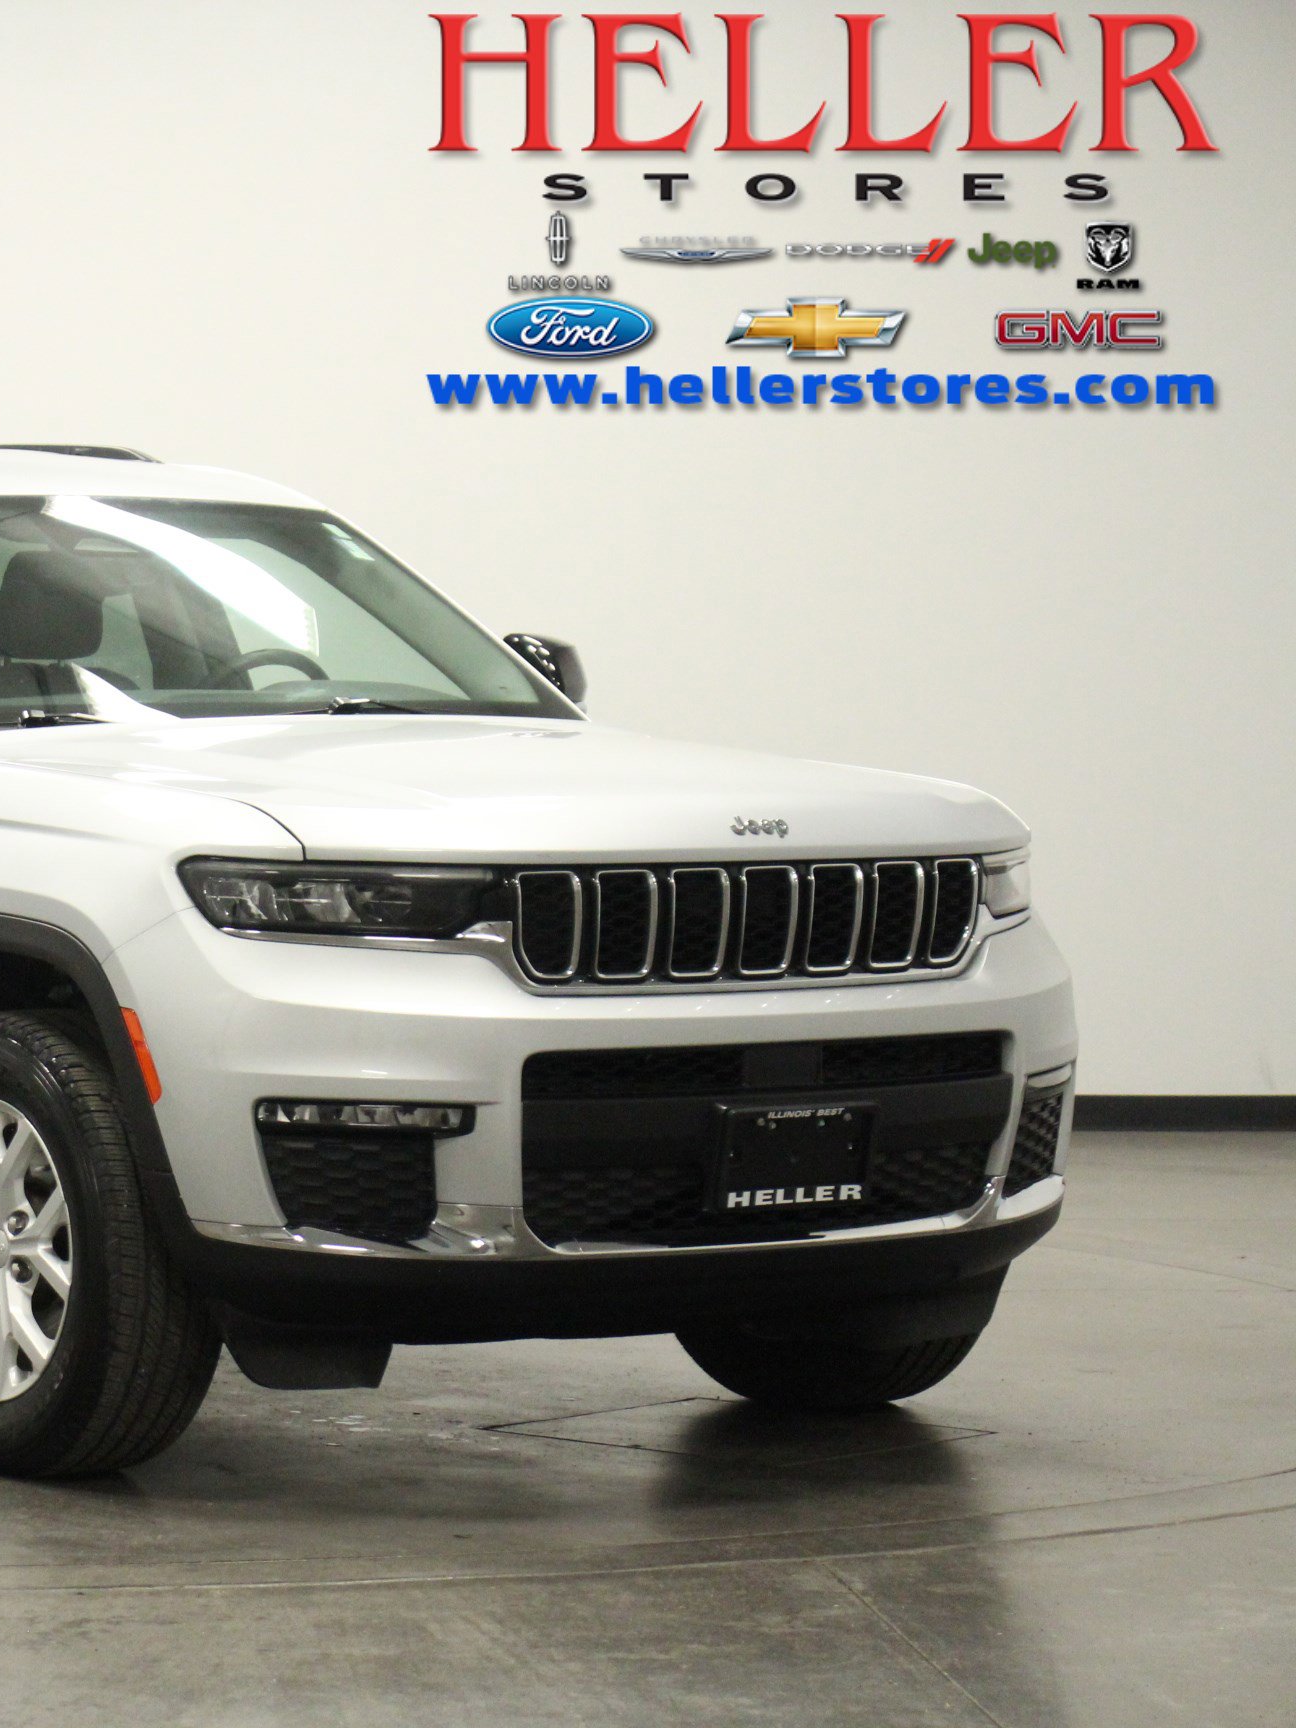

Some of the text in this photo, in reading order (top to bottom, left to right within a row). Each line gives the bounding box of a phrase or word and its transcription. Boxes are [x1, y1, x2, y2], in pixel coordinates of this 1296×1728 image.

[730, 815, 790, 839] Jeep
[816, 1107, 846, 1117] BEST
[727, 1184, 862, 1209] HELLER
